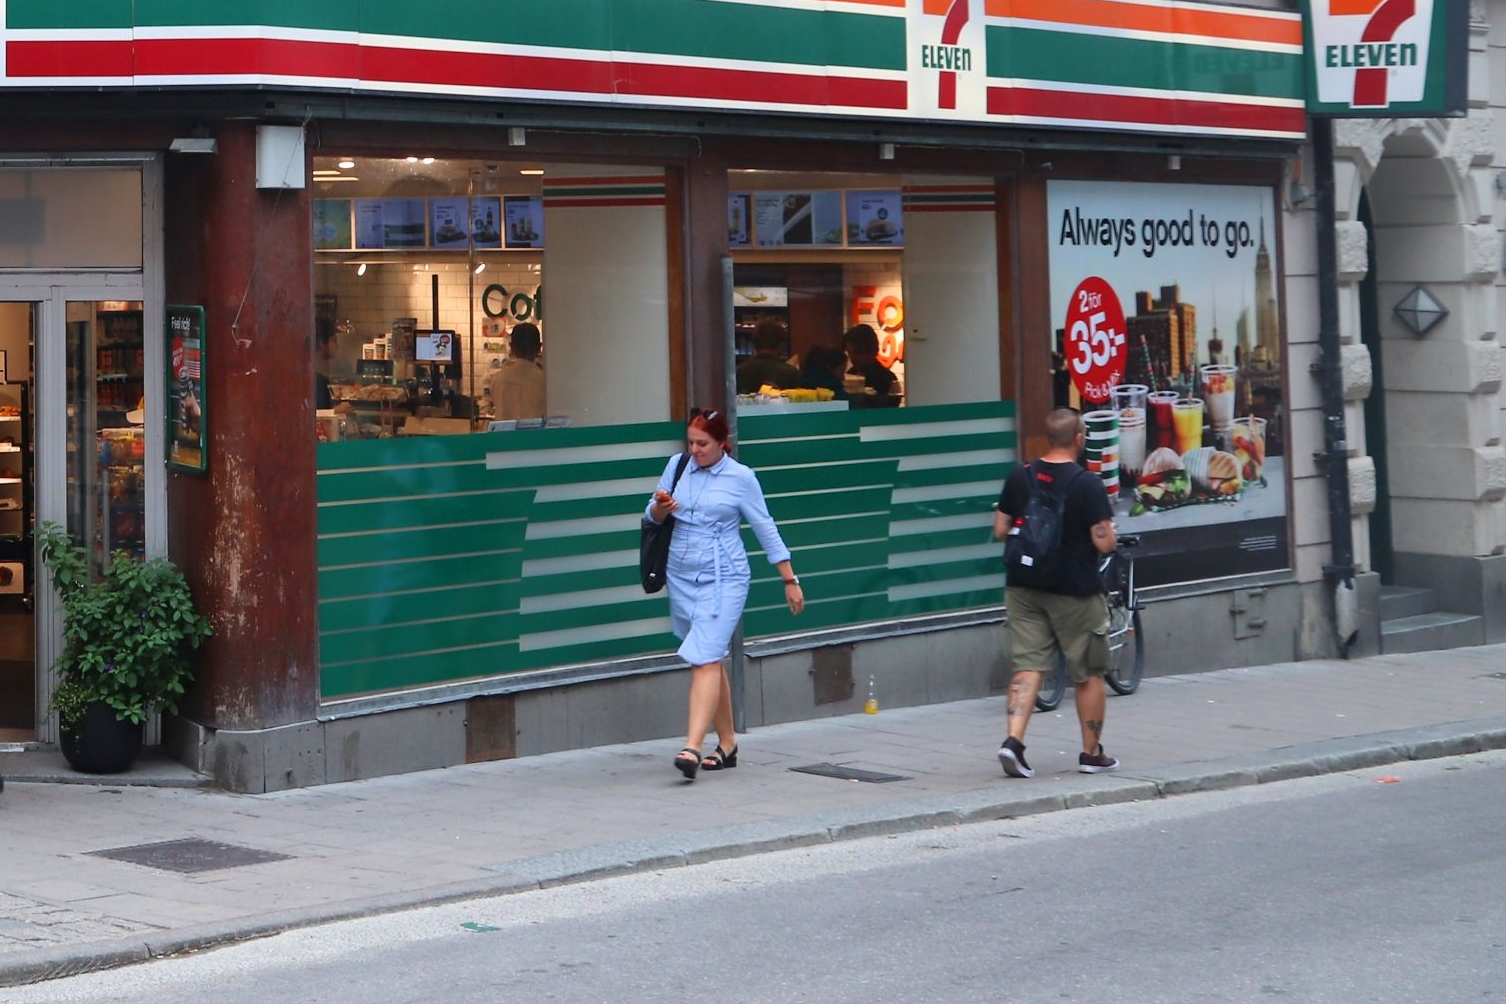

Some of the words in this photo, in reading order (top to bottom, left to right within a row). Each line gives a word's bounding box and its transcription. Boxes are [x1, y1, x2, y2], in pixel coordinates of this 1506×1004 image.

[1060, 207, 1136, 258] Always
[1142, 209, 1194, 258] good
[1200, 214, 1219, 246] to
[1225, 220, 1255, 258] go.
[1079, 290, 1089, 313] 2
[1070, 312, 1125, 374] 35:-
